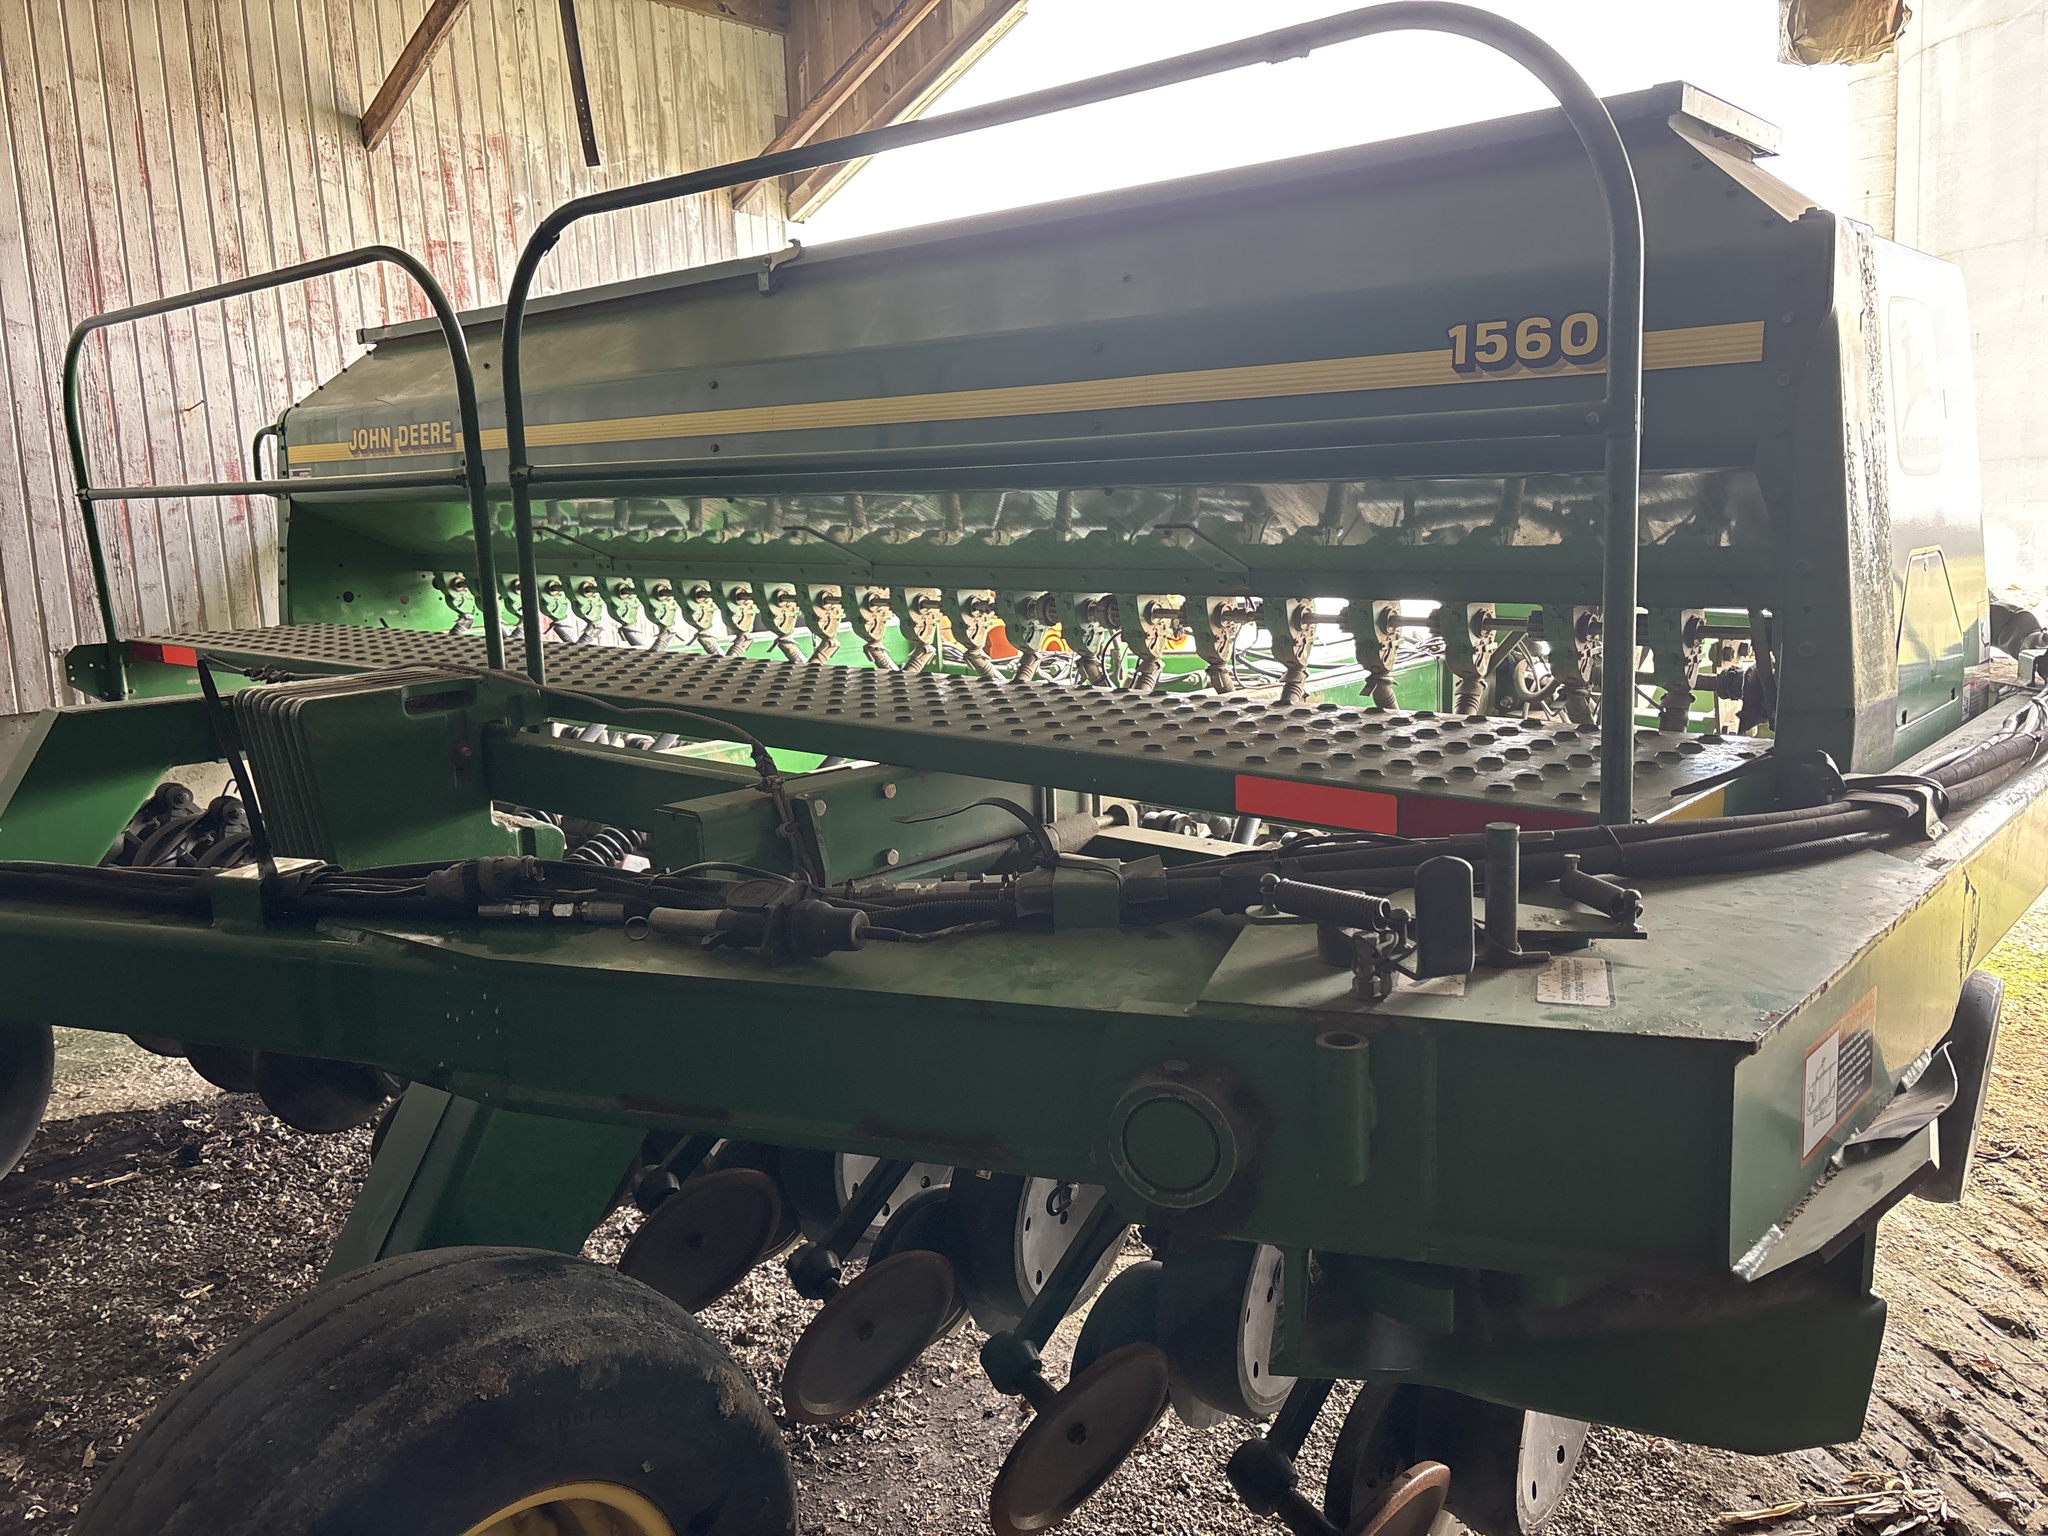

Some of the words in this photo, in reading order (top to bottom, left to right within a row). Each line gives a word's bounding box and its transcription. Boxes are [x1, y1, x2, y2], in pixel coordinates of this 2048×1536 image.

[1447, 311, 1600, 366] 1560
[349, 426, 393, 453] JOHN
[397, 420, 453, 449] DEERE
